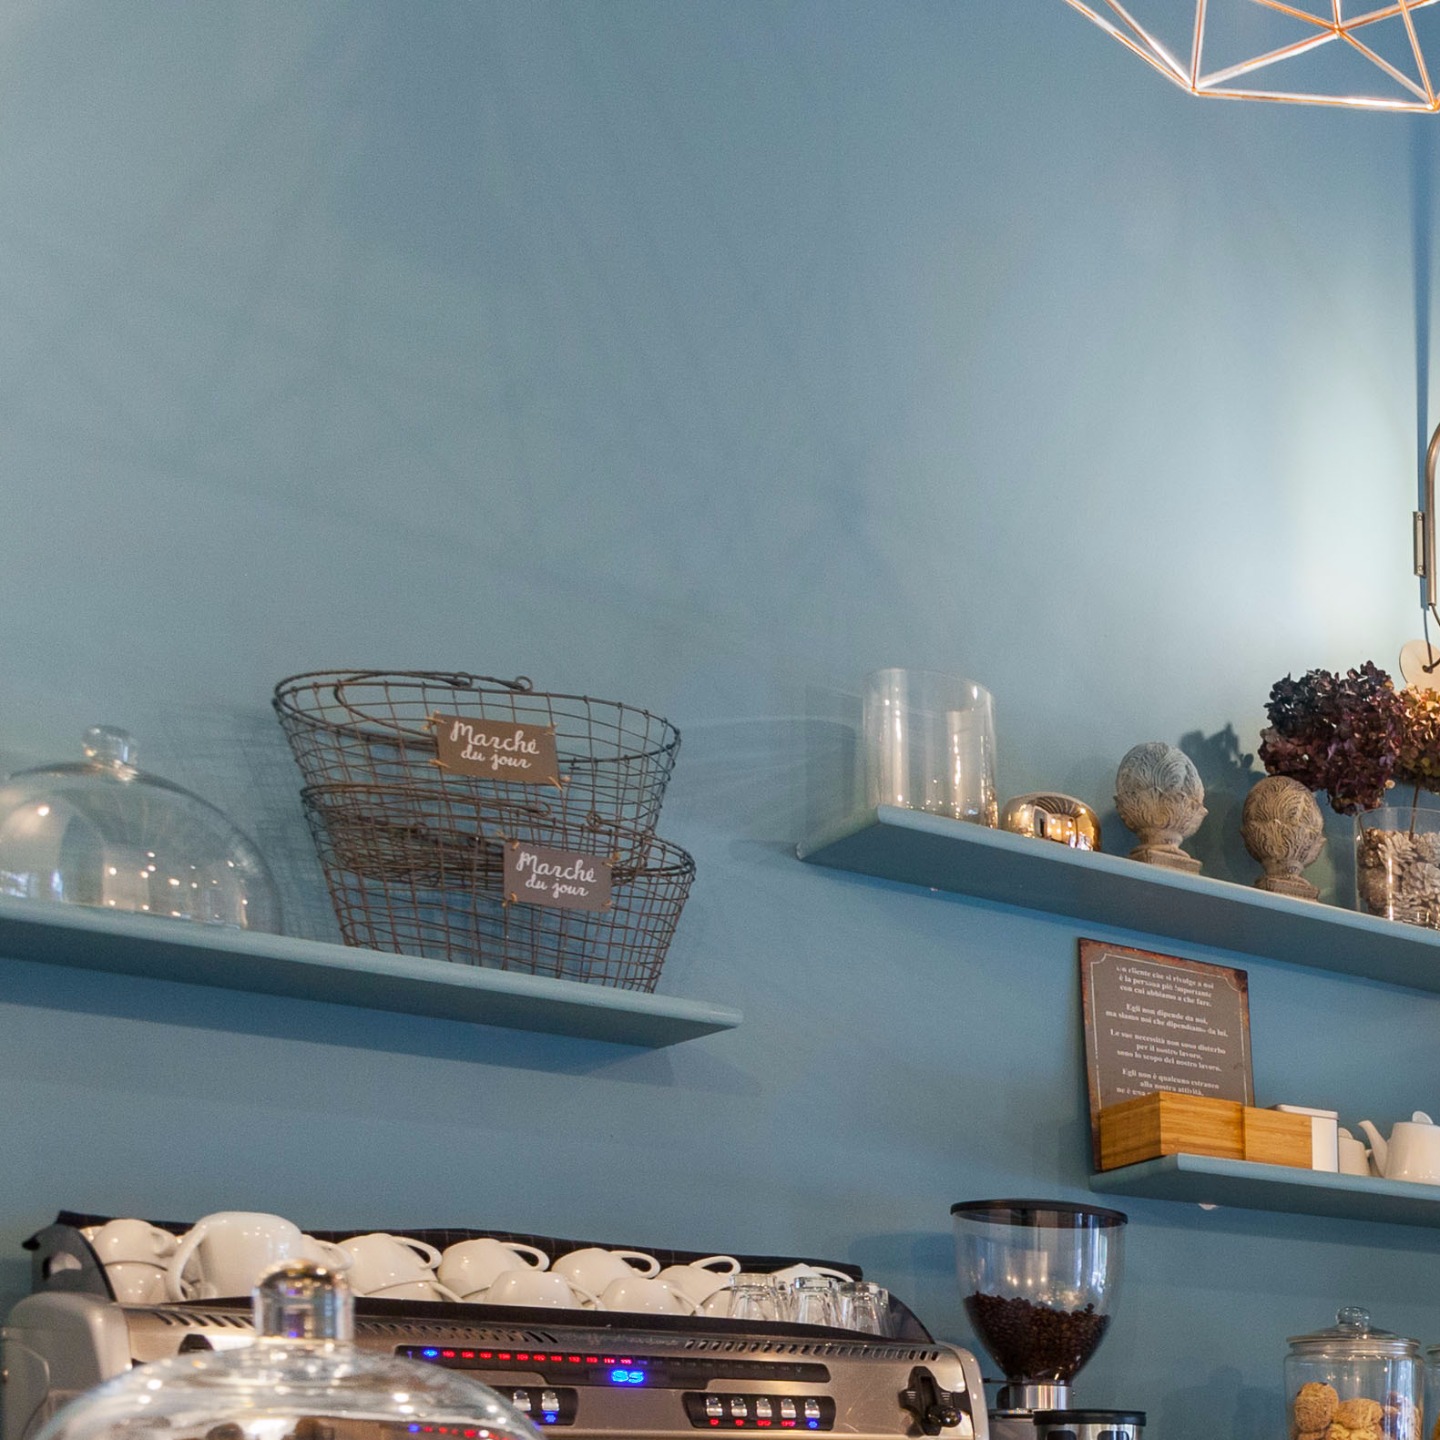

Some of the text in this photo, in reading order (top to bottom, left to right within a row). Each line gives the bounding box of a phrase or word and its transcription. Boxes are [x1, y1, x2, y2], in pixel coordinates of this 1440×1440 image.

[460, 746, 532, 771] du jour
[525, 876, 589, 899] du jour
[1128, 968, 1150, 977] cliente
[1173, 976, 1196, 986] rivolge
[1133, 979, 1160, 988] persona
[1175, 985, 1212, 998] importante
[1146, 989, 1176, 1000] abbiamo
[1118, 1012, 1139, 1020] siamo
[1166, 1022, 1206, 1032] dipendiamo
[1126, 1004, 1140, 1013] Egli
[1142, 1007, 1155, 1015] non
[1157, 1009, 1183, 1020] dipende
[1185, 1014, 1193, 1022] da
[1135, 1034, 1165, 1044] necessità
[1143, 1055, 1162, 1063] scopo
[1156, 1047, 1178, 1055] nostro
[1122, 1068, 1137, 1077] Egli
[1158, 1075, 1190, 1085] qualcuno
[1191, 1080, 1219, 1089] estraneo
[1154, 1083, 1176, 1092] nostra
